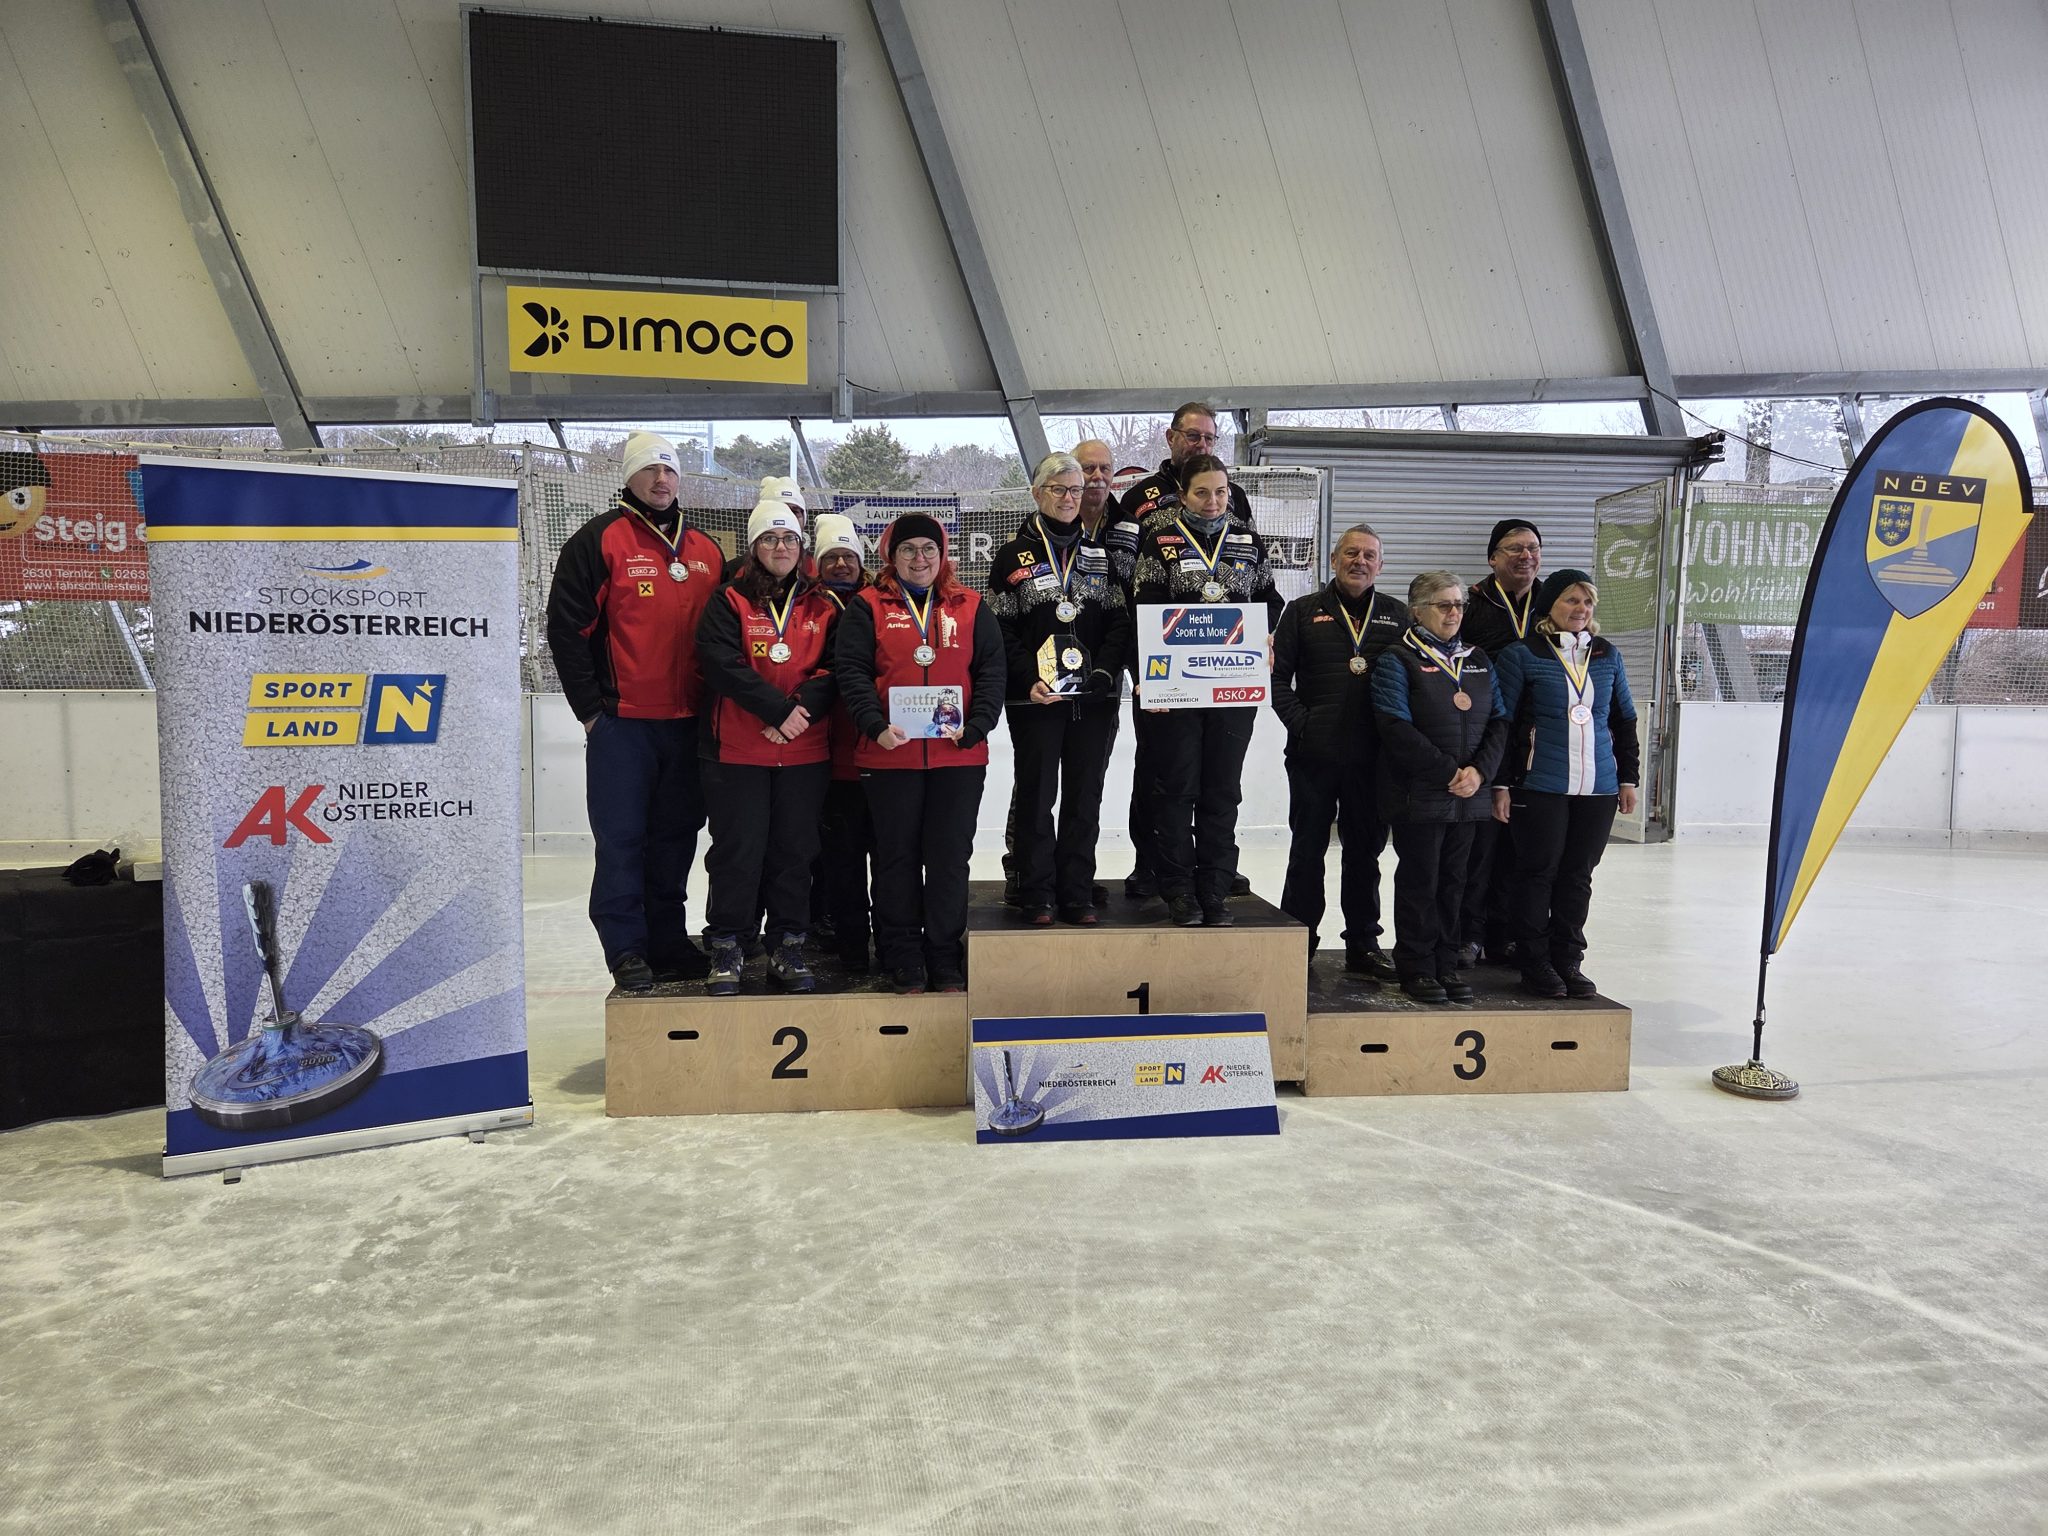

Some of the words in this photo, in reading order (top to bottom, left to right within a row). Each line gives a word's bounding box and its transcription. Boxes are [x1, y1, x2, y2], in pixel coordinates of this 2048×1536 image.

[583, 314, 794, 359] DIMOCO
[1883, 475, 1977, 497] NÖEV
[34, 512, 127, 553] Steig
[23, 568, 52, 578] 2630
[258, 587, 427, 608] STOCKSPORT
[189, 609, 489, 638] NIEDERÖSTERREICH
[1189, 614, 1213, 624] Hechtl
[1175, 627, 1197, 638] SPORT
[1199, 627, 1205, 637] &
[1206, 627, 1228, 637] MORE
[1188, 656, 1255, 667] SEIWALD
[264, 682, 353, 698] SPORT
[1216, 688, 1247, 700] ASKÖ
[266, 721, 338, 738] LAND
[222, 784, 333, 848] AK
[339, 781, 429, 800] NIEDER
[323, 800, 473, 822] ÖSTERREICH
[1127, 982, 1150, 1014] 1
[772, 1026, 809, 1079] 2
[1453, 1030, 1487, 1080] 3
[1039, 1079, 1116, 1088] NIEDERÖSTERREICH
[1200, 1065, 1227, 1084] AK
